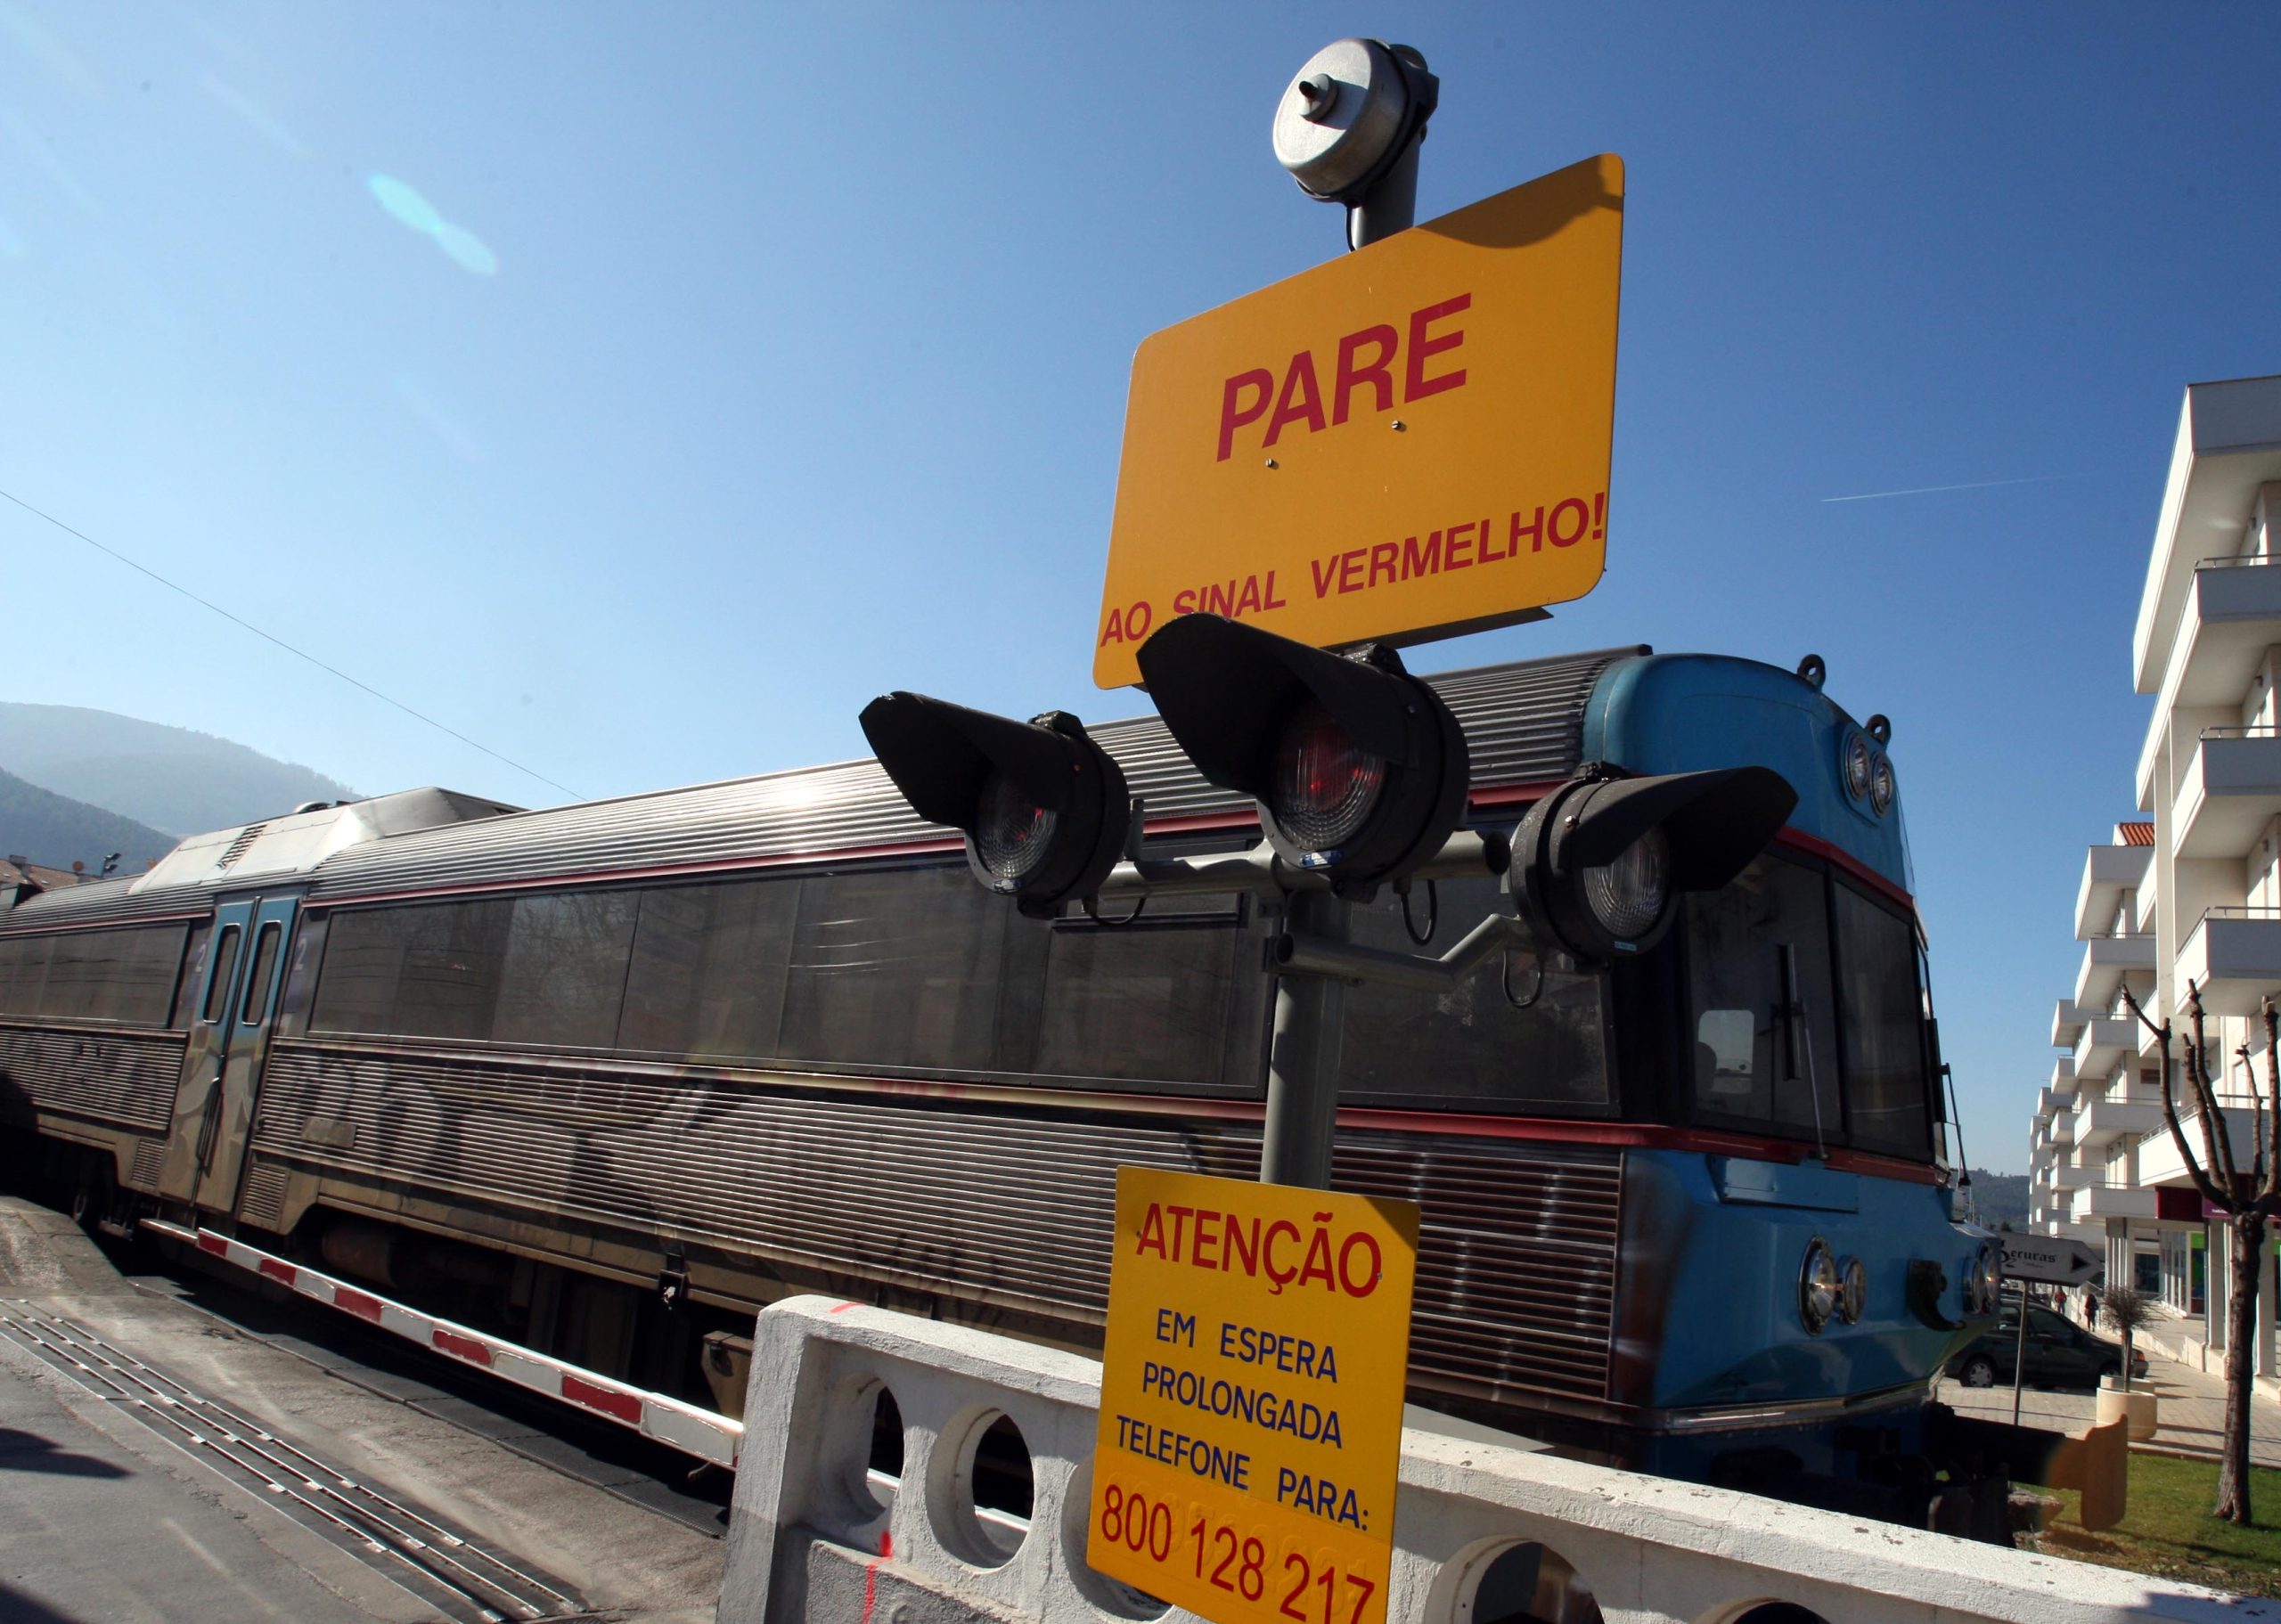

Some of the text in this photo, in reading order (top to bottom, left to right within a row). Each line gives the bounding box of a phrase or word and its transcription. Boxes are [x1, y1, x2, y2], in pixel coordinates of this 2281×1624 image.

[1217, 292, 1471, 462] PARE
[1100, 492, 1605, 647] AO SINAL VERMELHO!
[293, 938, 307, 970] 2
[1136, 1202, 1382, 1298] ATENÇÃO
[1157, 1309, 1337, 1383] EM ESPERA
[1142, 1361, 1342, 1449] PROLONGADA
[1116, 1415, 1369, 1531] TELEFONE PARA:
[1101, 1484, 1376, 1624] 800 128 217
